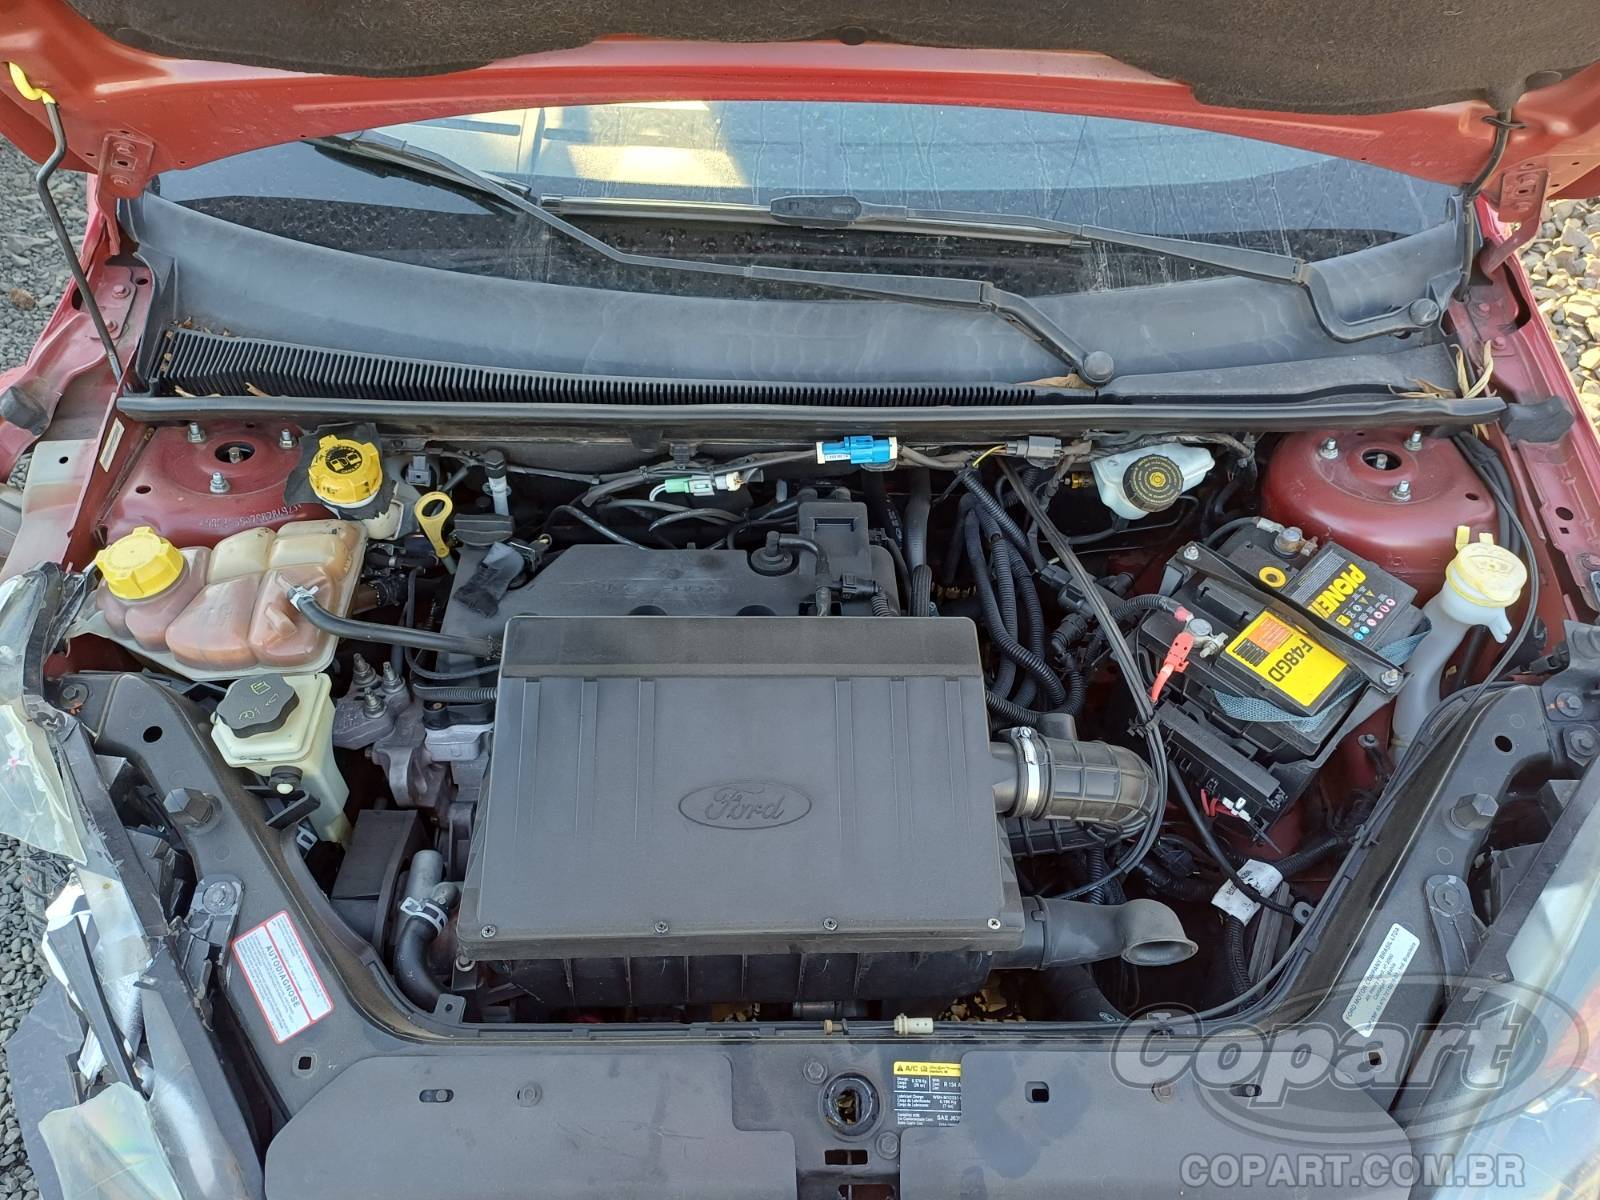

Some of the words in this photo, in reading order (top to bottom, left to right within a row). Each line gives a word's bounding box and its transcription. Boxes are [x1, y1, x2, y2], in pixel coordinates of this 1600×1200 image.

[1307, 563, 1366, 620] PIONEI
[1268, 638, 1313, 682] F48GD
[705, 786, 785, 820] Ford
[265, 945, 300, 1007] AUTODIAGNOSE
[1346, 1003, 1357, 1020] FORD
[1354, 985, 1368, 1003] MOTOR
[1379, 941, 1392, 959] BRASIL
